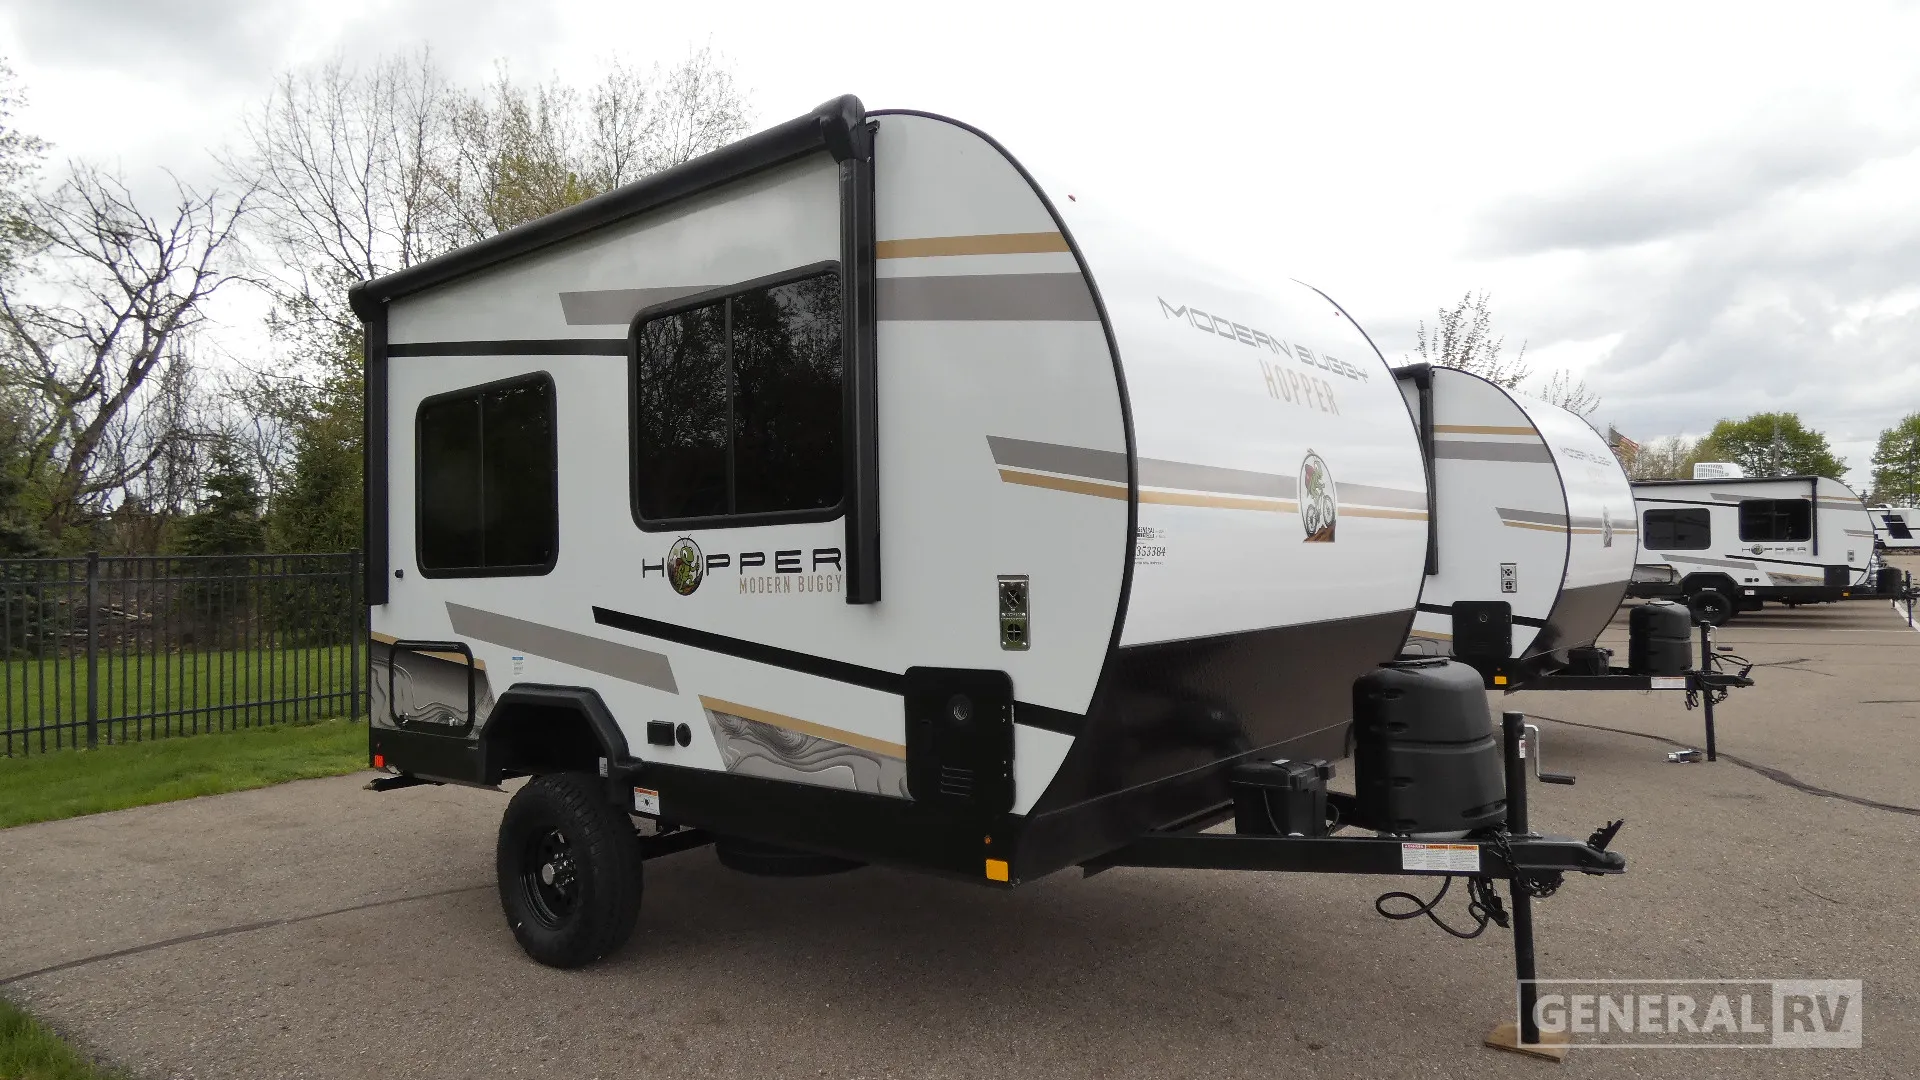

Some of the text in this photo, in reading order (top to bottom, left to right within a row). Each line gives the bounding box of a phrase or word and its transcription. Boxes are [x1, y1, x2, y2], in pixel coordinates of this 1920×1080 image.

[1157, 295, 1369, 384] MODERN BUGGY
[1259, 358, 1340, 416] HOPPER
[739, 575, 842, 594] MODERN BUGGY
